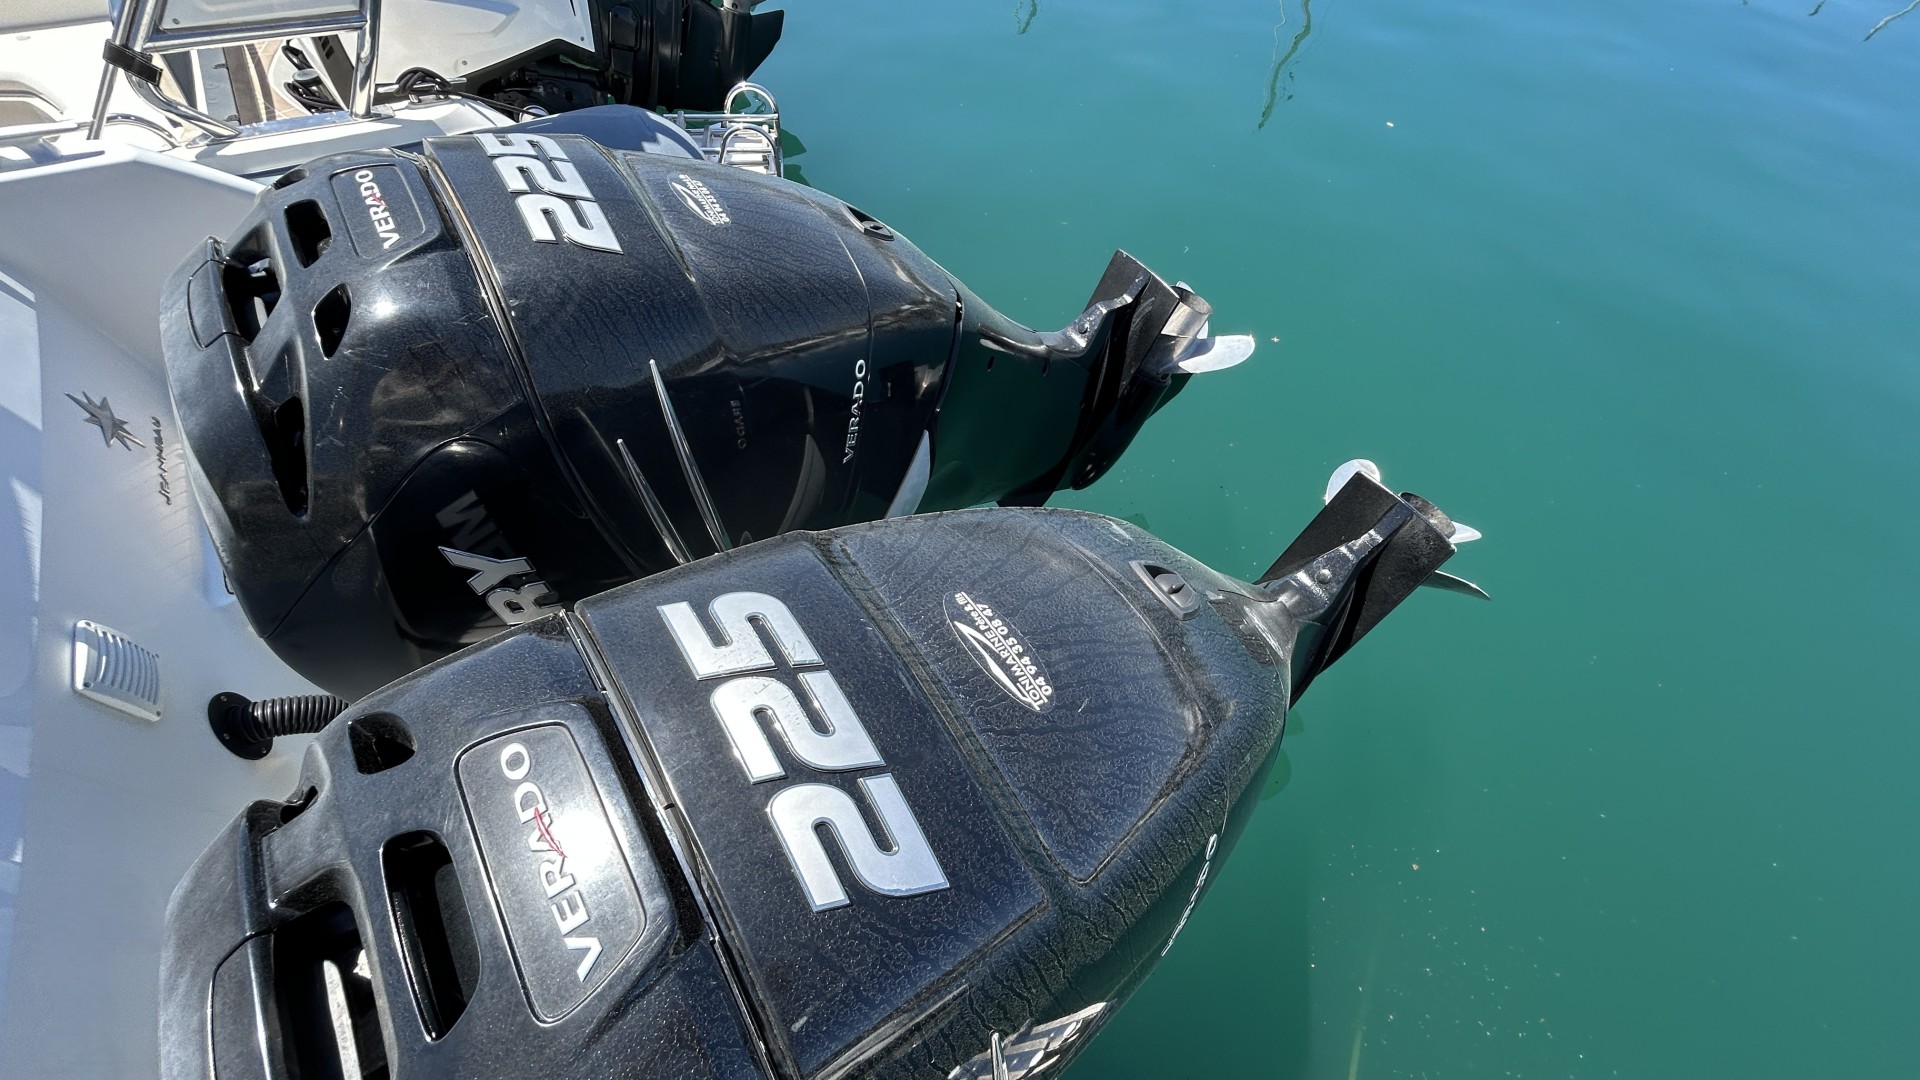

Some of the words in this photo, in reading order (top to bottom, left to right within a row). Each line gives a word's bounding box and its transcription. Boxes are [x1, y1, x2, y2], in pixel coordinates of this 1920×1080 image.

[354, 169, 401, 250] VERADO
[474, 133, 624, 255] 225
[842, 359, 866, 464] VERADO
[976, 603, 994, 617] 47
[991, 619, 1009, 635] 08
[1005, 637, 1023, 654] 35
[984, 629, 1044, 709] TONIMARINE
[1020, 656, 1037, 675] 94
[1035, 676, 1053, 696] 04
[656, 591, 950, 914] 225
[499, 742, 604, 983] VERADO
